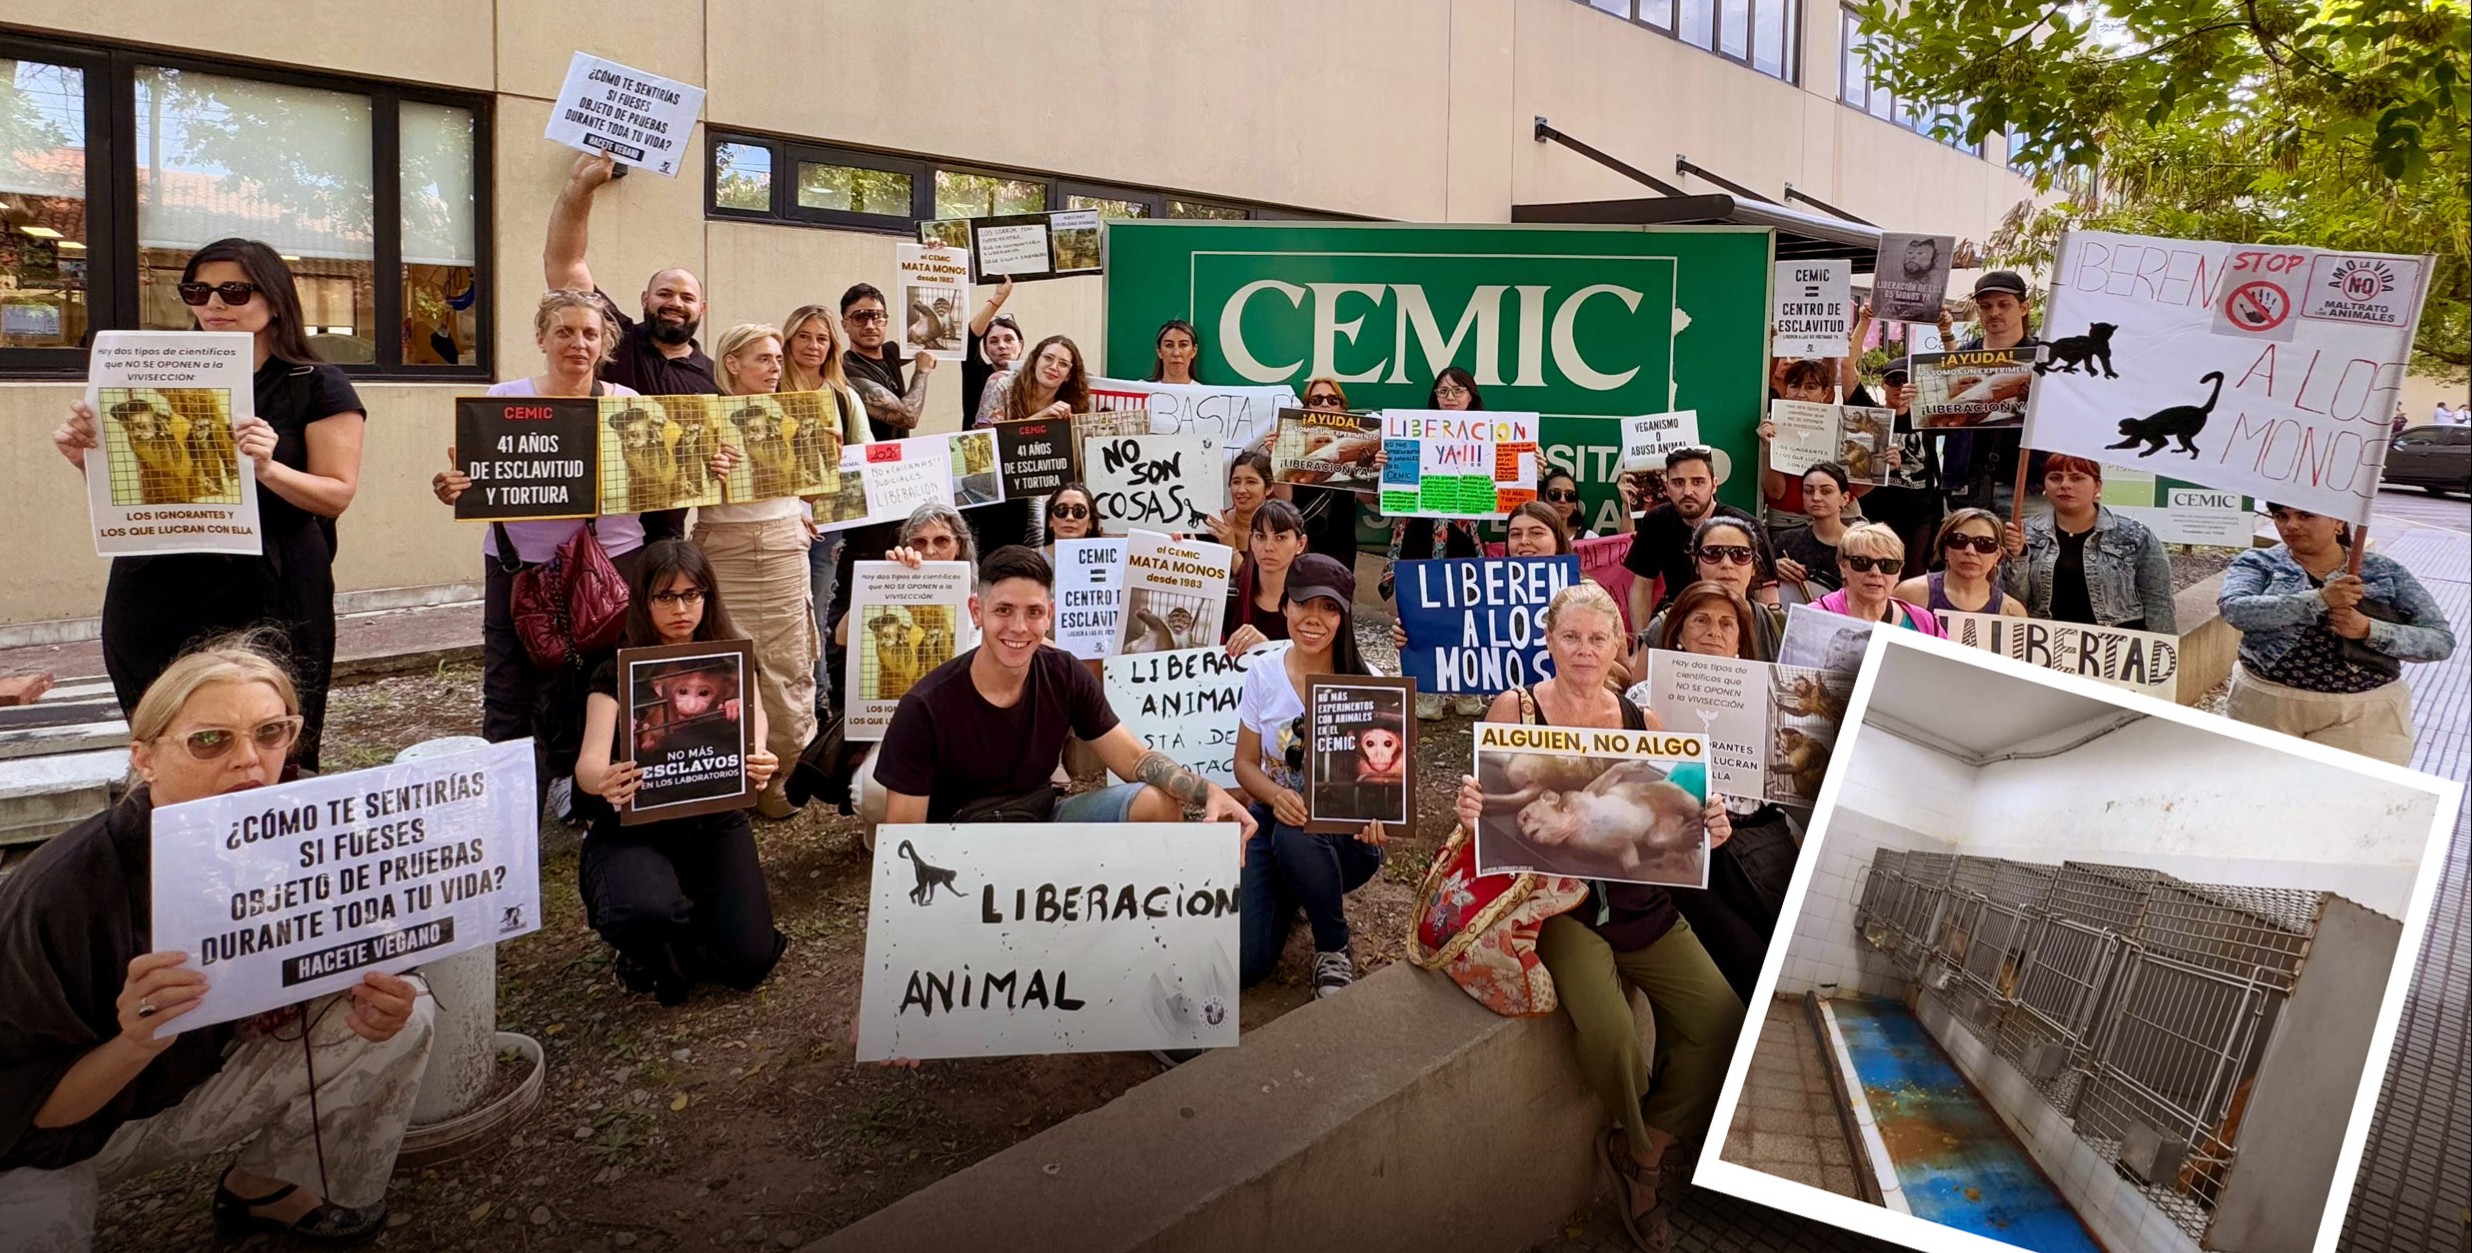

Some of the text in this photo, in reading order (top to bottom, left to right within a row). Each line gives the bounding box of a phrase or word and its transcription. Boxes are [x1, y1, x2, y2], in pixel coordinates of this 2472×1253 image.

[588, 69, 681, 105] ¿CÓMO TE SENTIRÍAS
[607, 90, 652, 112] SI FUESES
[579, 97, 668, 134] OBJETO DE PRUEBAS
[565, 109, 672, 151] DURANTE TODA TU VIDA?
[902, 262, 966, 275] MATA MONOS
[2234, 252, 2304, 274] STOP
[1795, 269, 1830, 282] CEMIC
[2328, 260, 2356, 288] AMO
[2374, 261, 2394, 292] VIDA
[2348, 277, 2374, 294] NO
[1782, 303, 1841, 315] CENTRO DE
[2325, 301, 2388, 313] MALTRATO
[2329, 310, 2395, 322] ANIMALES
[1778, 320, 1844, 333] ESCLAVITUD
[1218, 279, 1645, 391] CEMIC
[135, 348, 160, 357] tipos
[1941, 351, 2014, 367] ¡AYUDA!
[105, 362, 123, 370] que
[2236, 344, 2410, 425] A LOS
[504, 407, 553, 419] CEMIC
[1150, 392, 1254, 440] BASTA
[1302, 413, 1360, 428] ¡AYUDA!
[1019, 425, 1047, 435] CEMIC
[1294, 426, 1319, 434] SOMOS
[1635, 418, 1678, 432] VEGANISMO
[497, 432, 559, 453] 41 AÑOS
[1656, 432, 1661, 441] O
[1017, 442, 1051, 456] 41 AÑOS
[1102, 439, 1140, 474] NO
[1631, 445, 1656, 456] ABUSO
[2220, 412, 2392, 498] MONOS
[470, 460, 584, 479] DE ESCLAVITUD
[1004, 458, 1067, 475] DE ESCLAVITUD
[1127, 451, 1182, 486] SON
[1014, 476, 1061, 490] Y TORTURA
[486, 486, 569, 505] Y TORTURA
[2174, 493, 2235, 508] CEMIC
[1095, 485, 1185, 524] COSAS
[127, 513, 152, 521] LOS
[155, 510, 225, 519] IGNORANTES
[101, 525, 252, 537] LOS QUE LUCRAN CON ELLA
[1079, 548, 1117, 564] CEMIC
[1157, 546, 1201, 559] el CEMIC
[1129, 555, 1225, 579] MATA MONOS
[1146, 574, 1202, 589] desde 1983
[1419, 561, 1568, 608] LIBEREN
[1065, 591, 1112, 607] CENTRO
[1463, 606, 1548, 649] A LOS
[1991, 621, 2176, 686] LIBERTAD
[1436, 647, 1551, 691] MONOS
[1672, 659, 1747, 674] Hay dos tipos de
[1676, 682, 1741, 697] NO SE OPONEN
[1724, 677, 1742, 687] que
[1318, 691, 1348, 702] NO MÁS
[1677, 693, 1685, 701] la
[1318, 701, 1374, 713] EXPERIMENTOS
[1318, 712, 1372, 724] CON ANIMALES
[1318, 726, 1338, 735] EN EL
[1318, 736, 1356, 752] CEMIC
[1481, 728, 1701, 756] ALGUIEN, NO ALGO
[667, 745, 714, 761] NO MÁS
[642, 754, 739, 779] ESCLAVOS
[1713, 757, 1758, 770] LUCRAN
[641, 769, 739, 790] EN LOS LABORATORIOS
[227, 771, 484, 850] ¿CÓMO TE SENTIRÍAS
[299, 818, 425, 868] SI FUESES
[231, 838, 484, 921] OBJETO DE PRUEBAS
[202, 865, 507, 966] DURANTE TODA TU VIDA?
[297, 922, 441, 979] HACETE VEGANO
